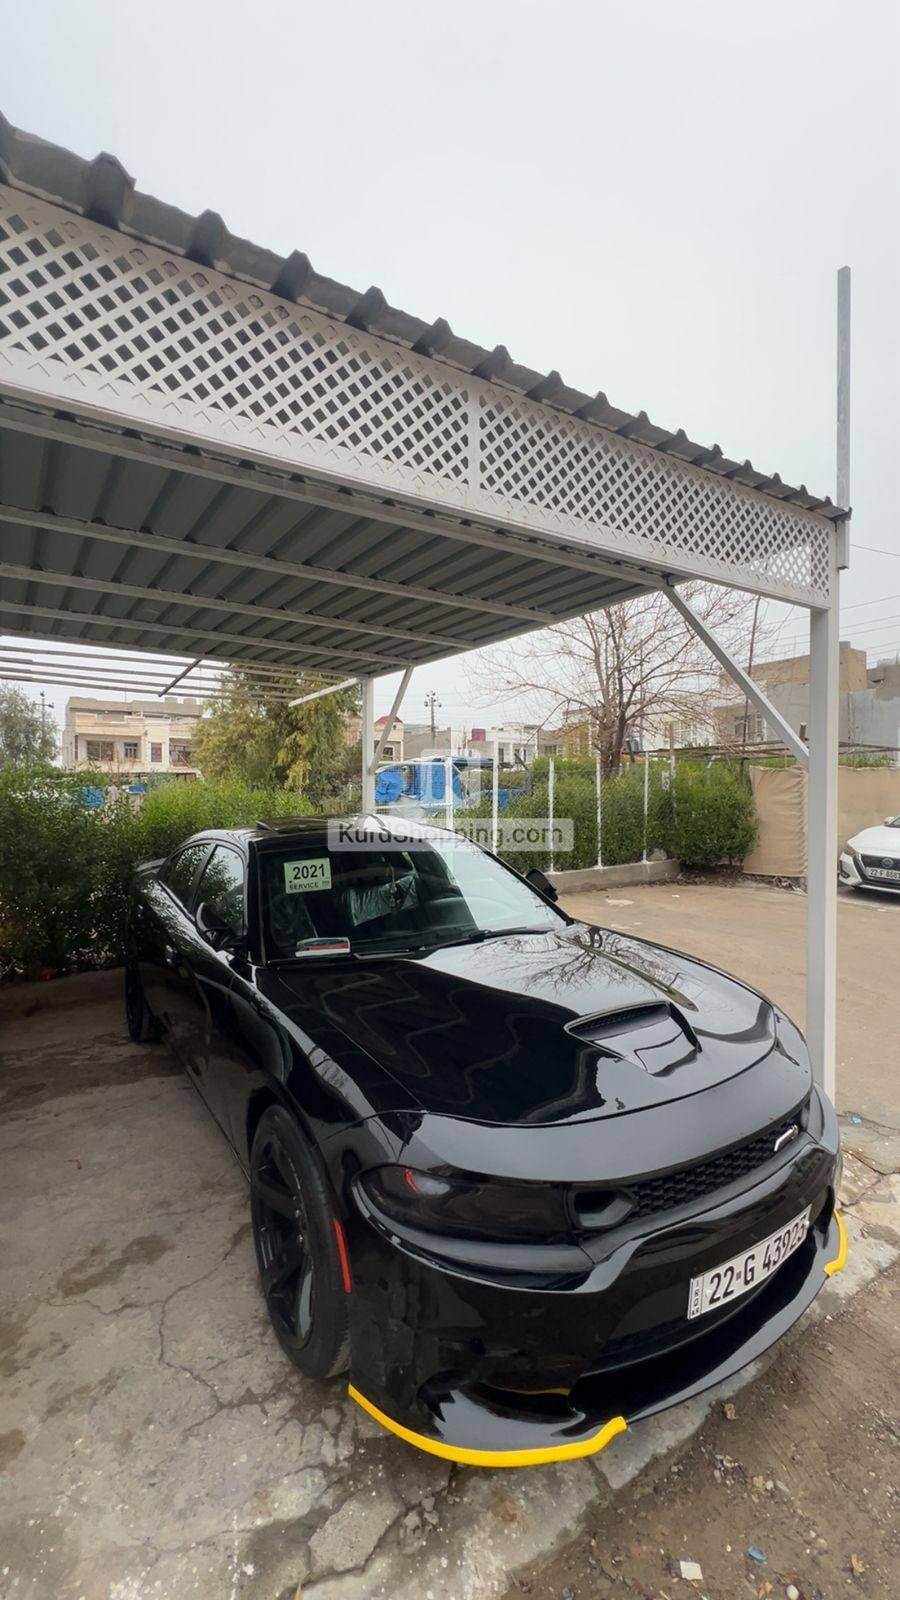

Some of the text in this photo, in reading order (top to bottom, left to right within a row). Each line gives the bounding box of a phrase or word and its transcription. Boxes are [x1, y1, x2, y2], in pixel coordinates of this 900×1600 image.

[293, 863, 325, 880] 2021
[289, 882, 319, 890] SERVICE
[762, 1214, 807, 1271] 43923
